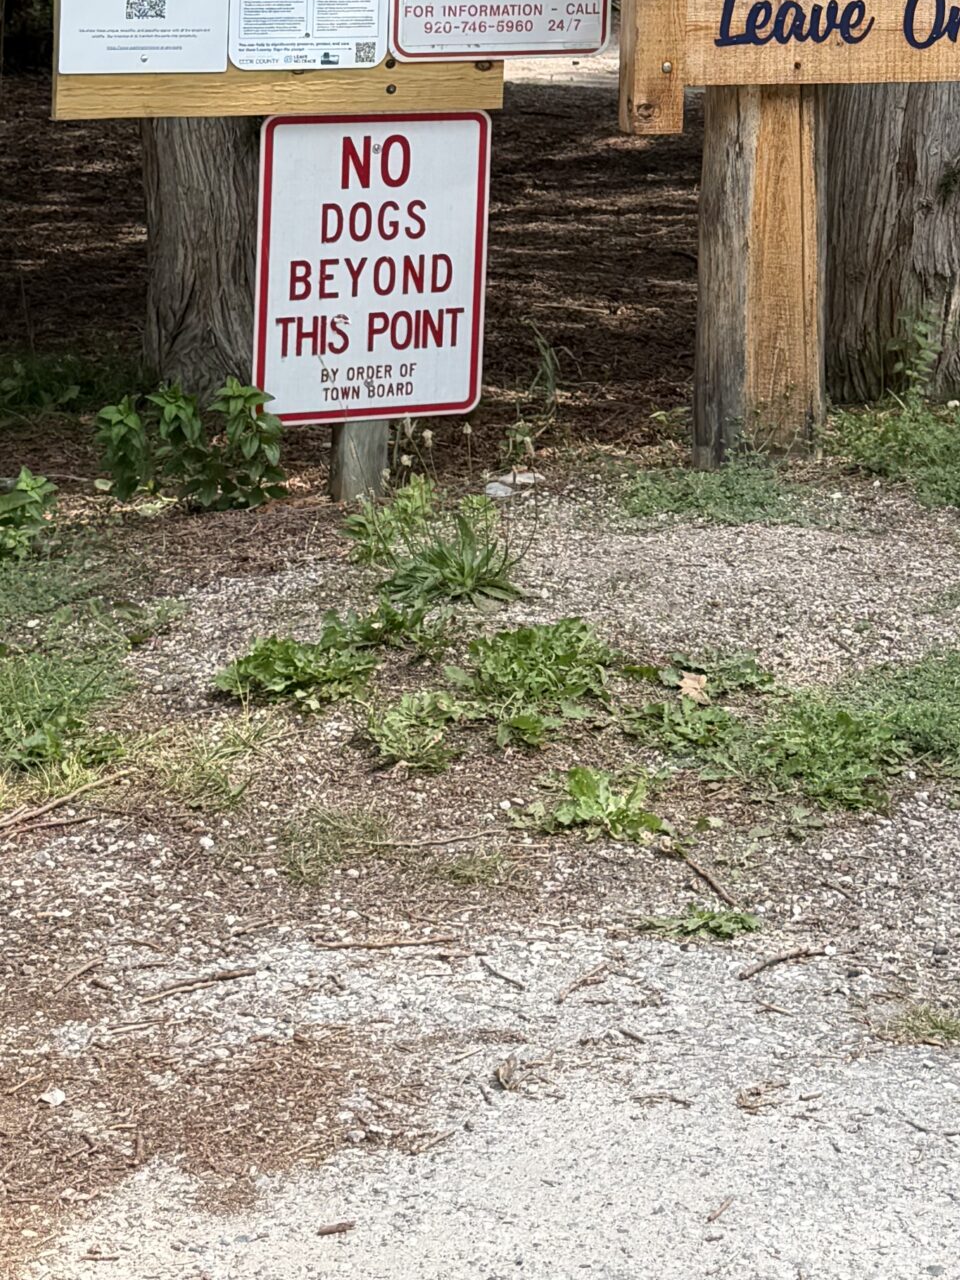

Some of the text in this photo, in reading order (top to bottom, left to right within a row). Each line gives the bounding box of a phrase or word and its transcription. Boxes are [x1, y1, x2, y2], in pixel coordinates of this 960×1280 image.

[404, 5, 434, 18] FOR
[442, 4, 543, 17] INFORMATION
[566, 3, 600, 15] CALL
[548, 19, 582, 32] 24/7
[341, 134, 411, 189] NO
[321, 200, 427, 244] DOGS
[289, 253, 453, 301] BEYOND
[276, 307, 464, 358] THIS POINT
[320, 363, 417, 383] BY ORDER OF
[323, 381, 413, 401] TOWN BOARD
